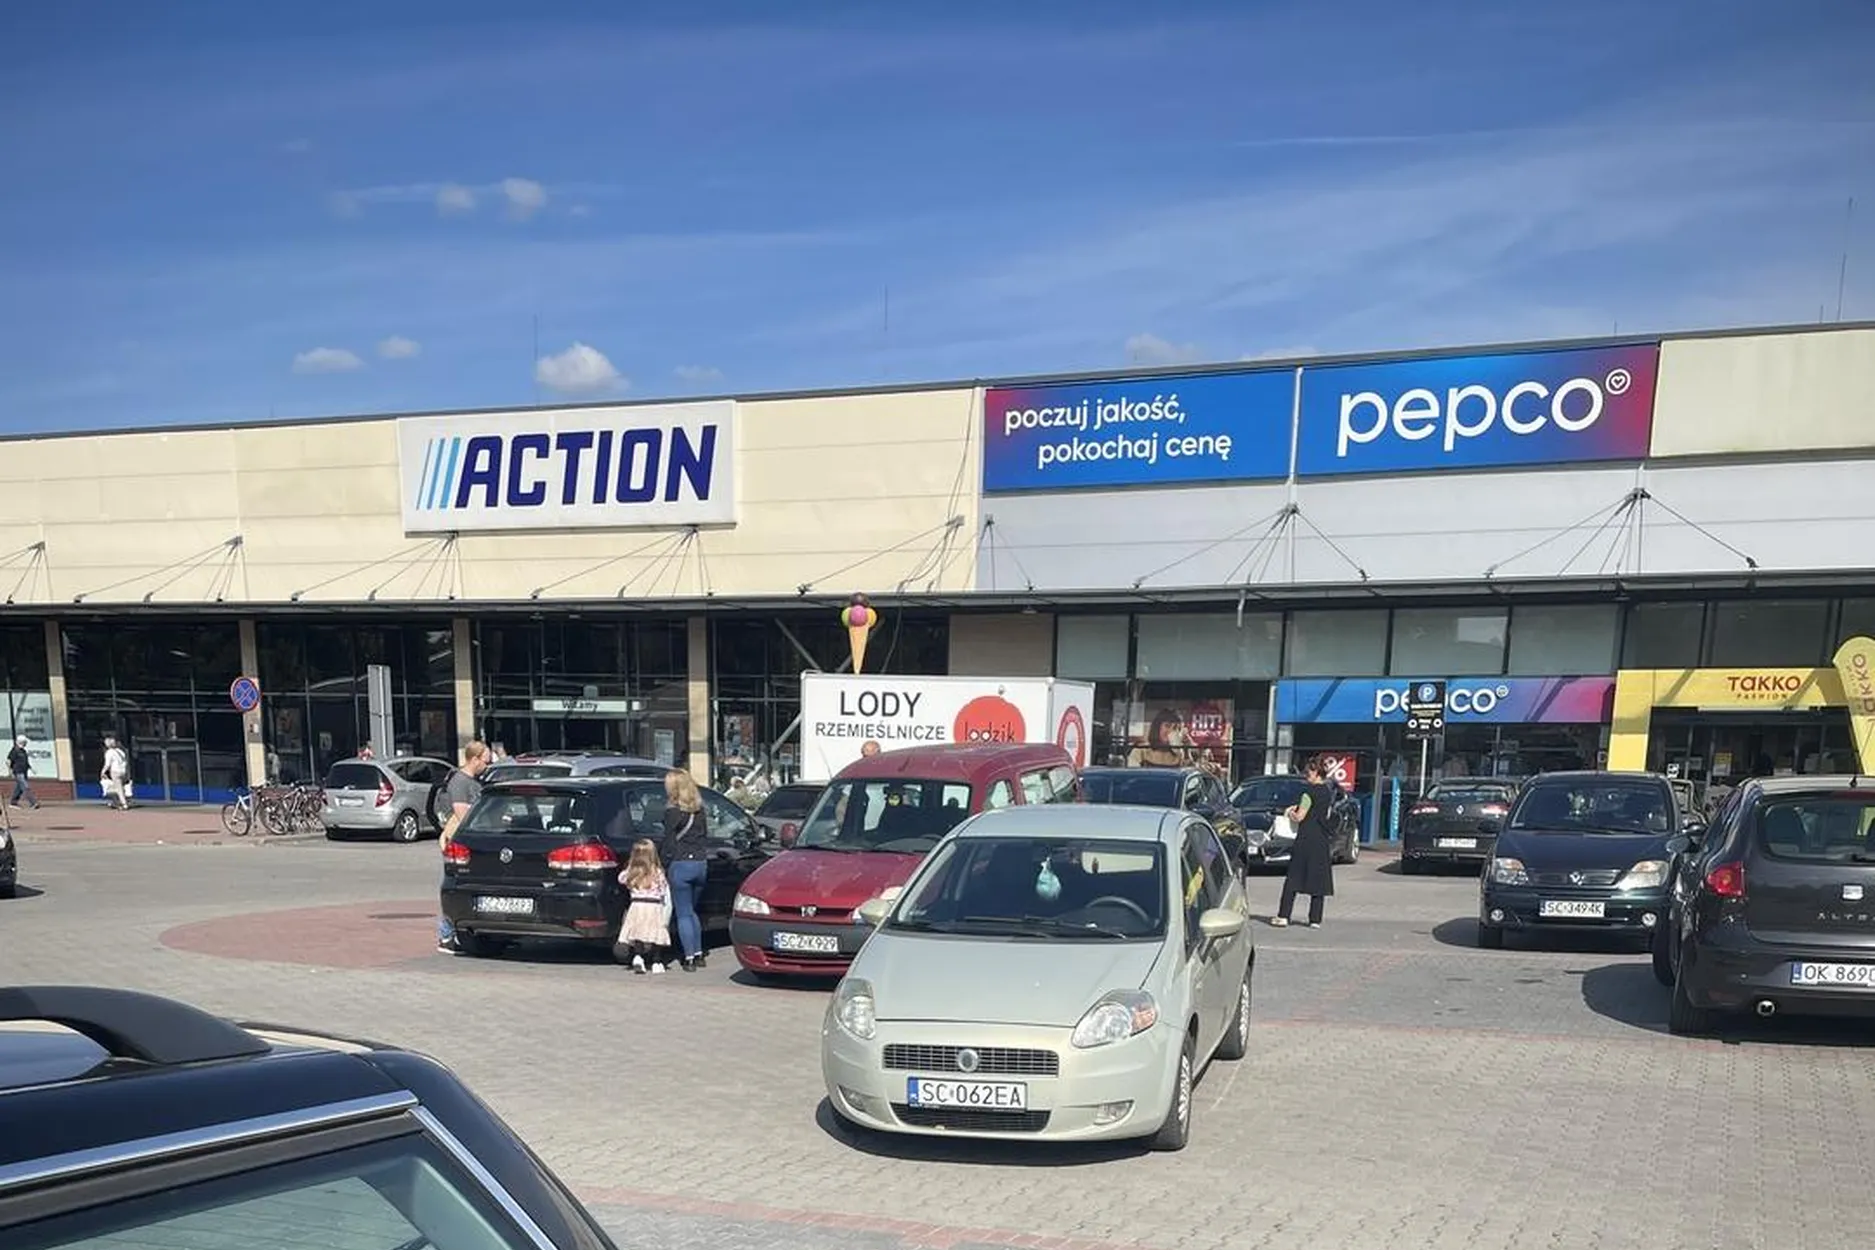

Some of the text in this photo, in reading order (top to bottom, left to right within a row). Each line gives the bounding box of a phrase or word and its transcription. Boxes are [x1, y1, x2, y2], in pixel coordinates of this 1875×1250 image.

[1004, 394, 1187, 435] poczuj jakość,
[1336, 378, 1604, 457] pepco
[454, 424, 718, 509] ACTION
[1038, 433, 1232, 469] pokochaj cenę
[840, 690, 922, 718] LODY
[815, 721, 946, 741] RZEMIEŚLNICZE
[1804, 965, 1829, 980] OK
